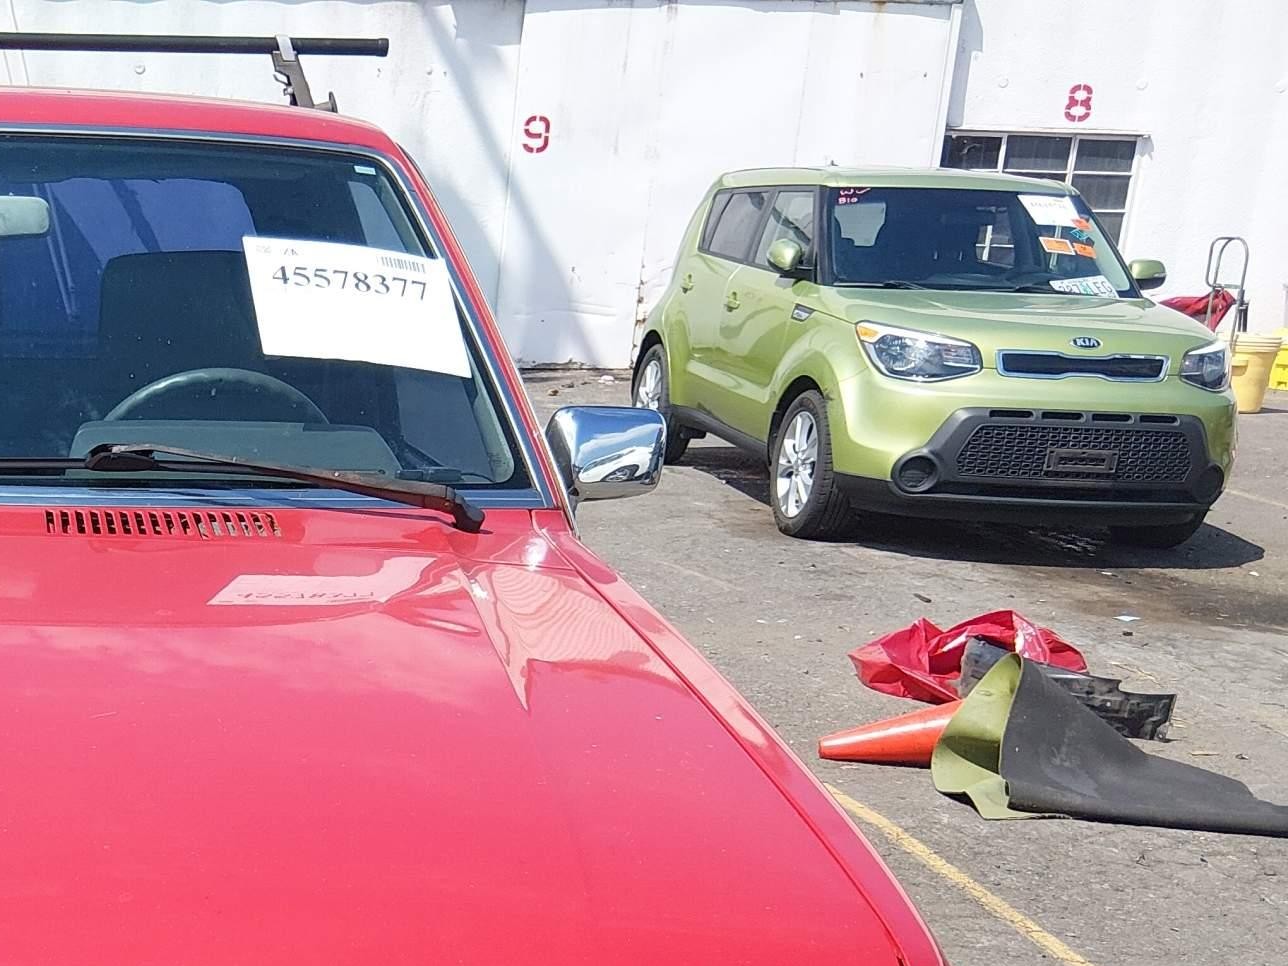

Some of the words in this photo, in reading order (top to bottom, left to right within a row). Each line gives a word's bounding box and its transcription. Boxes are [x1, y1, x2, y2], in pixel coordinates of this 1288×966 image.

[1064, 83, 1093, 122] 8
[522, 115, 550, 153] 9
[272, 264, 427, 301] 45578377
[1075, 338, 1098, 347] KIA
